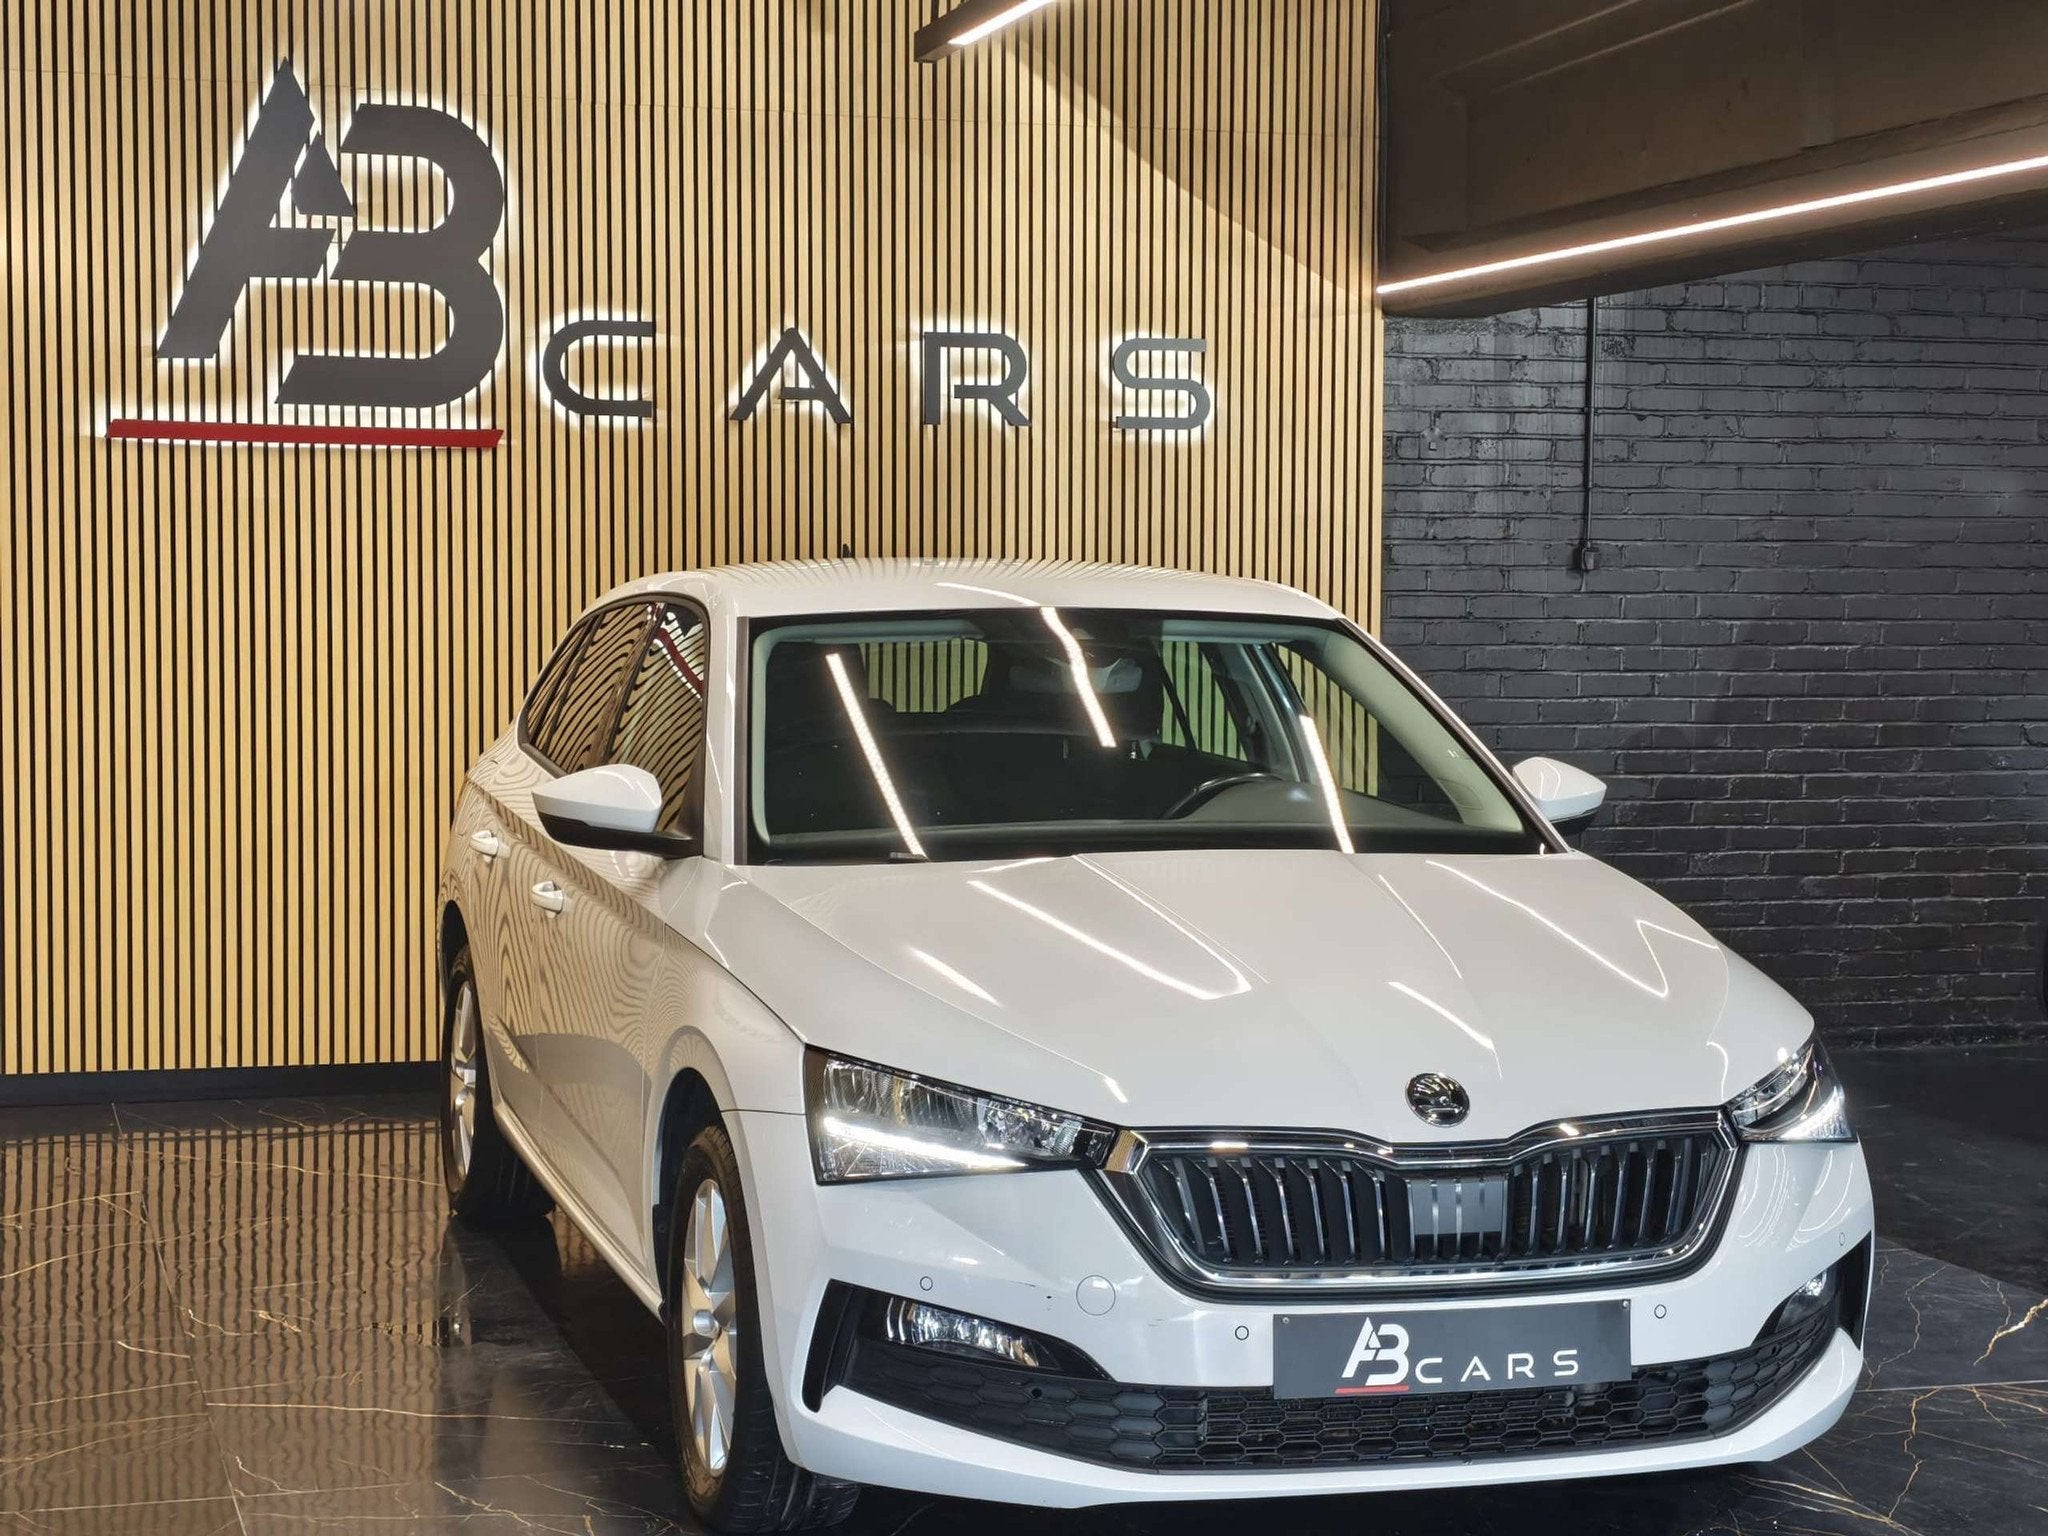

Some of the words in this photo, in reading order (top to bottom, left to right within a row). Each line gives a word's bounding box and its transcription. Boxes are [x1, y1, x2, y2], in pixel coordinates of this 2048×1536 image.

[156, 56, 504, 408] AB
[543, 319, 1211, 431] CARS
[1341, 1316, 1410, 1386] AB
[1415, 1349, 1579, 1384] CARS
